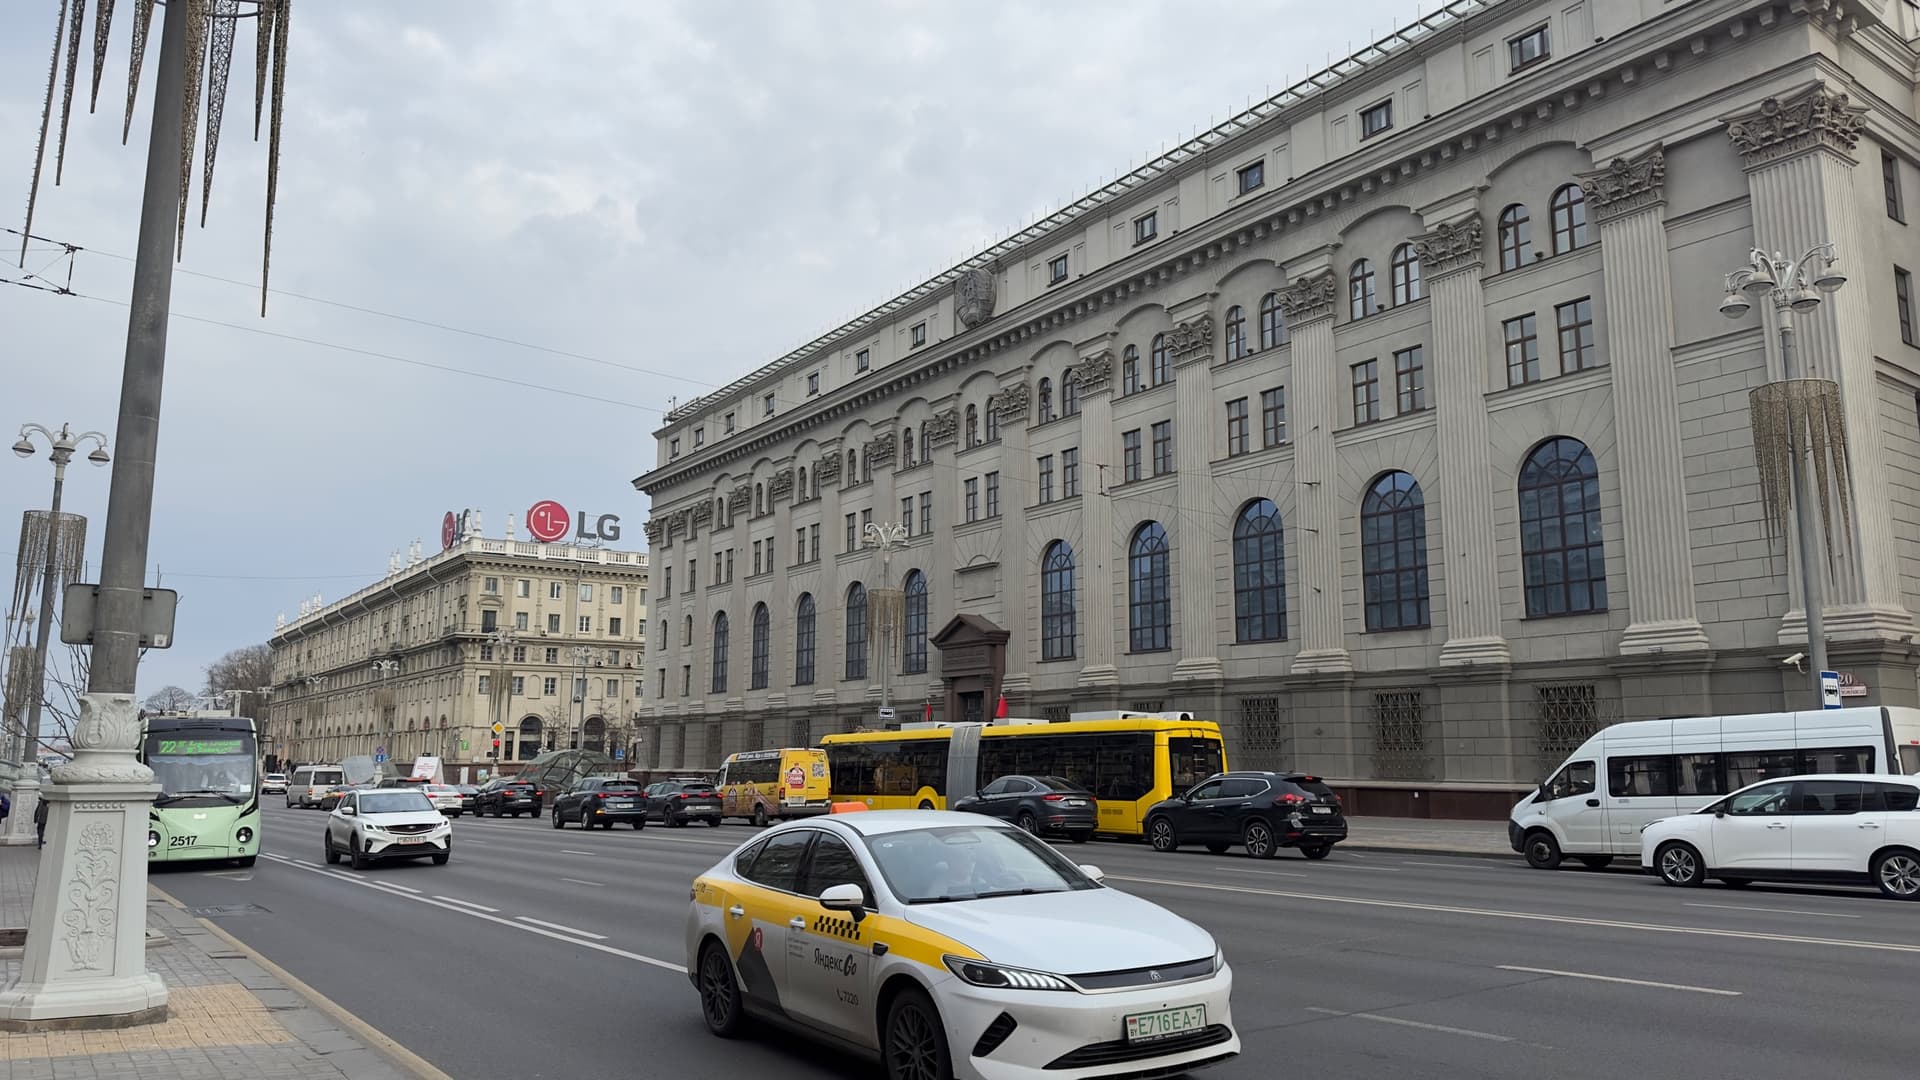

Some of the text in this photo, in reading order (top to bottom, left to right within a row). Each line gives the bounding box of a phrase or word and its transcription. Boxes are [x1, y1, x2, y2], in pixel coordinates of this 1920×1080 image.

[577, 510, 621, 541] LG
[160, 740, 177, 753] 22
[170, 835, 198, 847] 2517
[814, 947, 843, 973] Яндекс
[843, 954, 857, 976] Go
[842, 991, 859, 1006] 7220
[1138, 1007, 1203, 1036] E716EA-7
